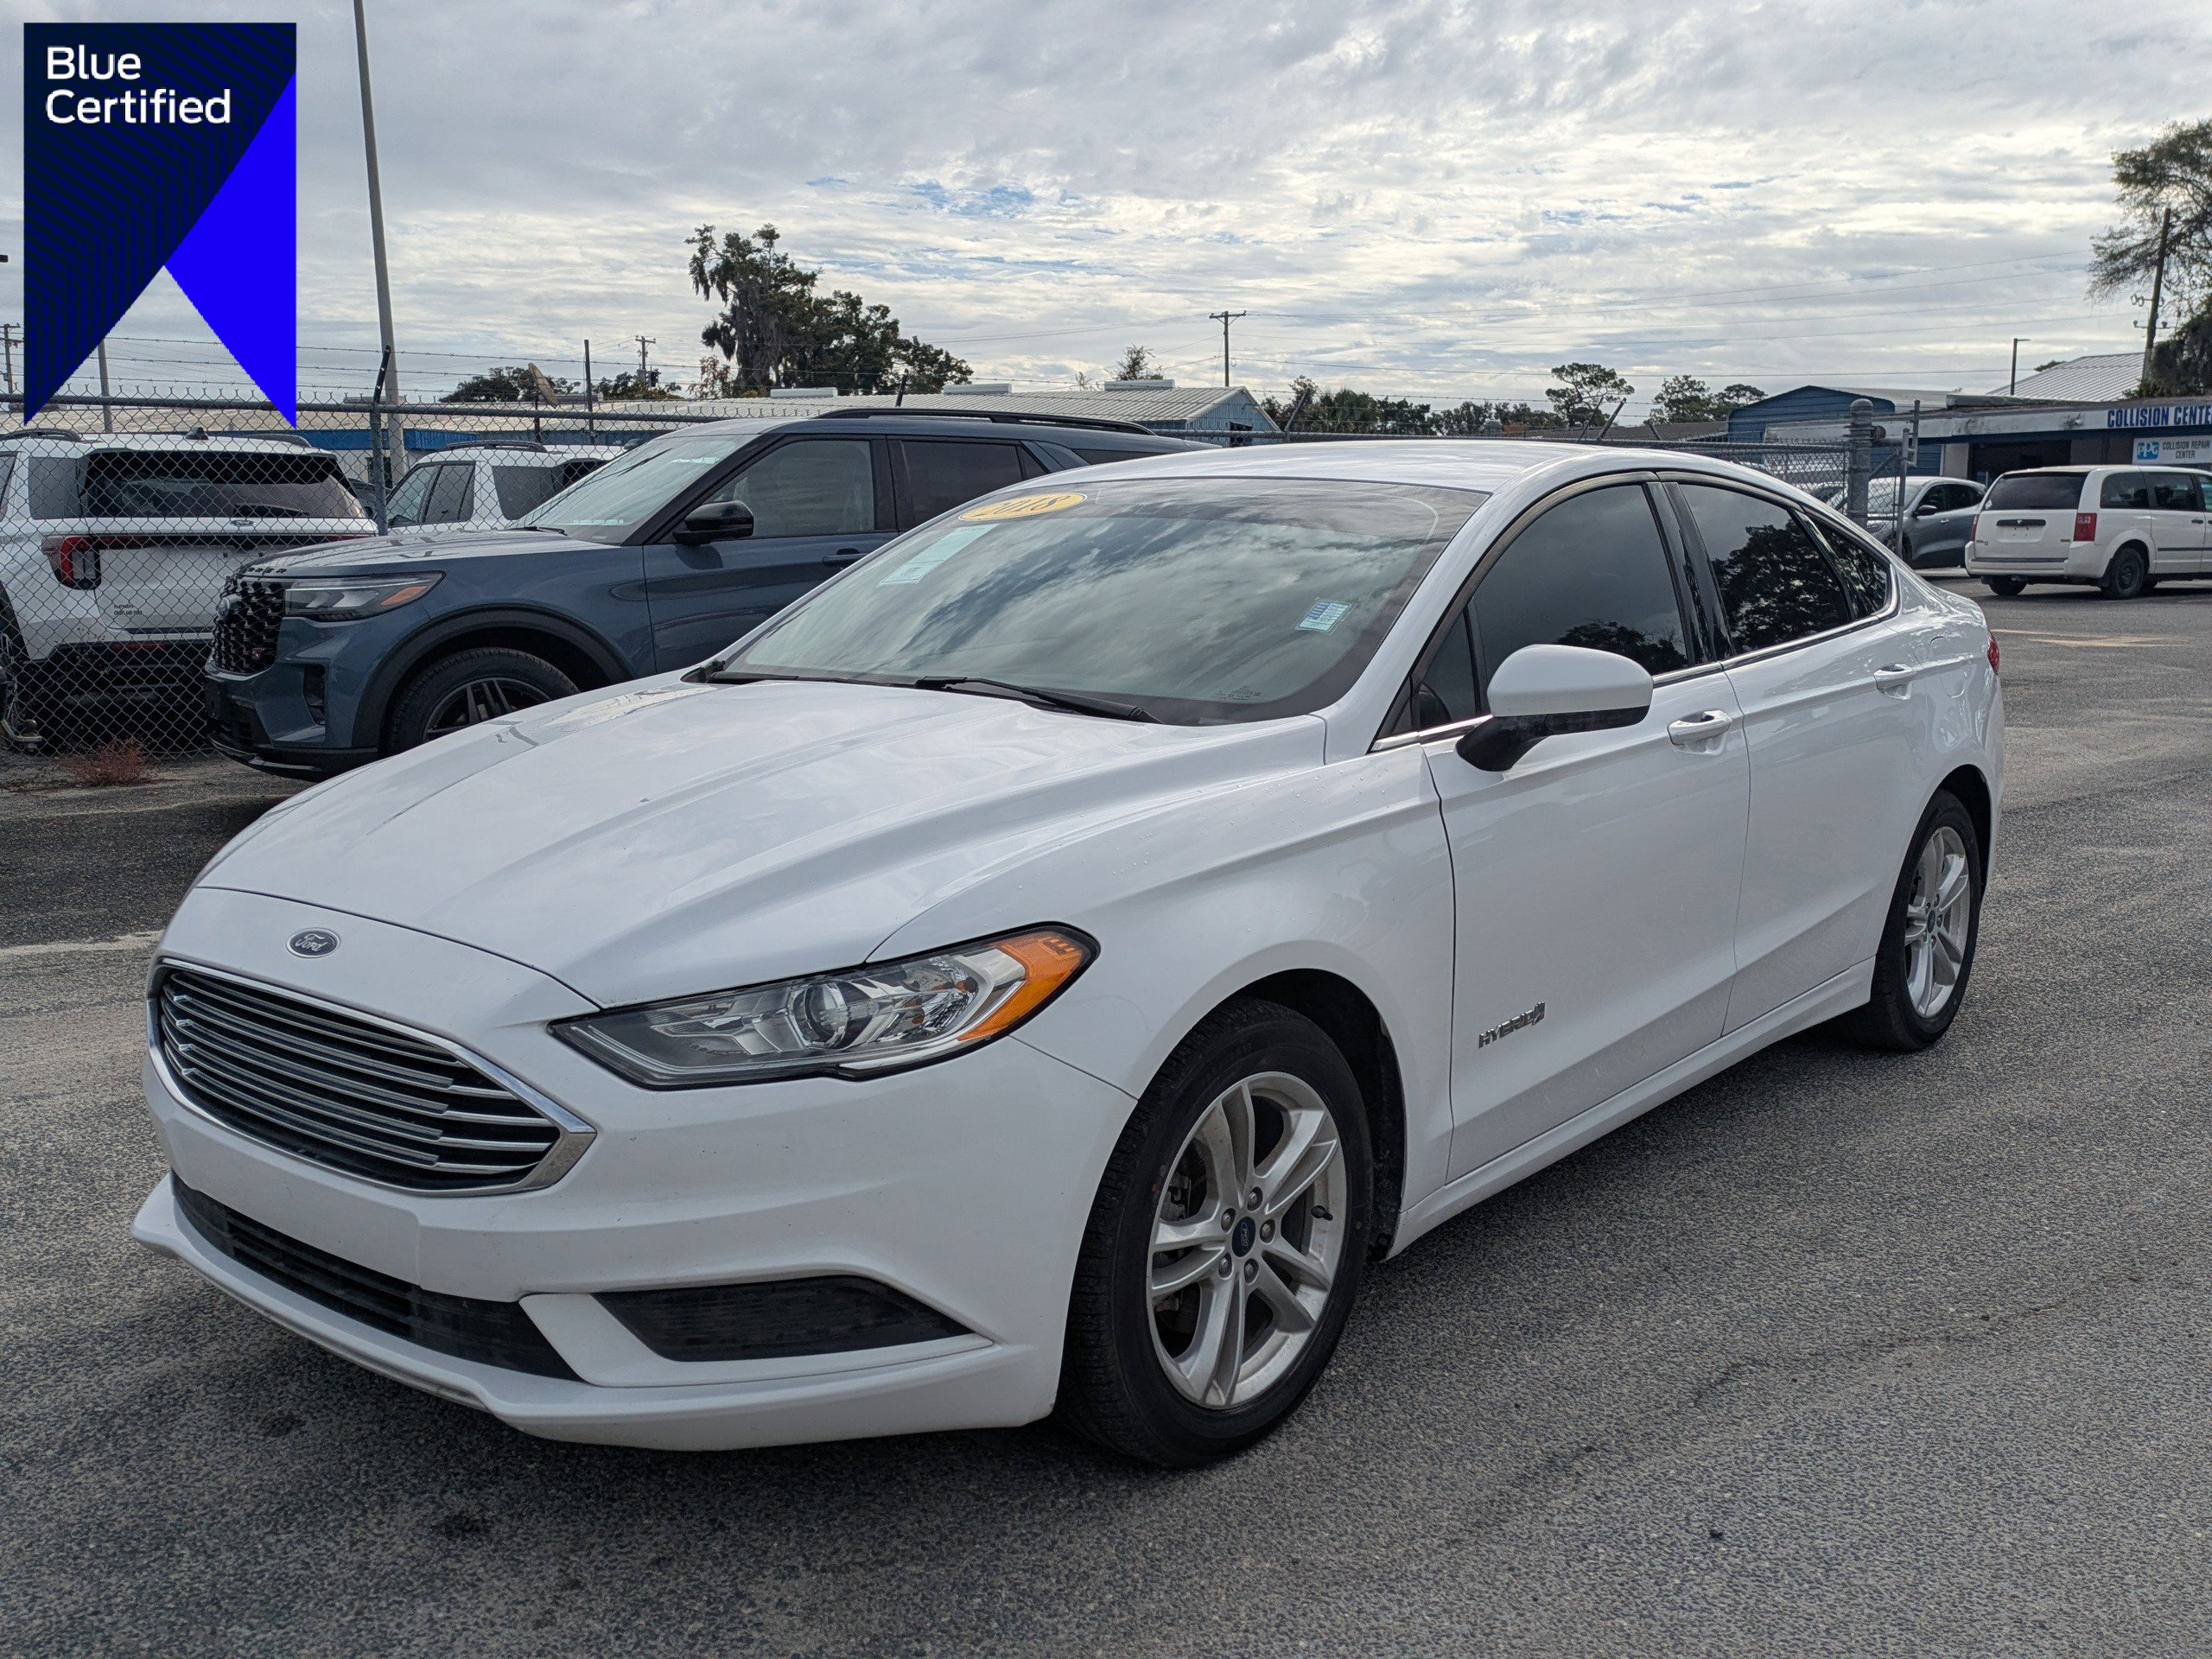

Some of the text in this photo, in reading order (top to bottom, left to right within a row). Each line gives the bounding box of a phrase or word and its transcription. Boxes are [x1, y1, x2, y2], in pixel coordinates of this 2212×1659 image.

[2107, 405, 2212, 429] COLLISION CENTE
[2137, 442, 2158, 459] PPG
[2162, 440, 2210, 451] COLLISION REPAIR
[2176, 450, 2196, 460] CENTER
[294, 932, 329, 953] Ford
[1478, 1009, 1535, 1049] HYBRID
